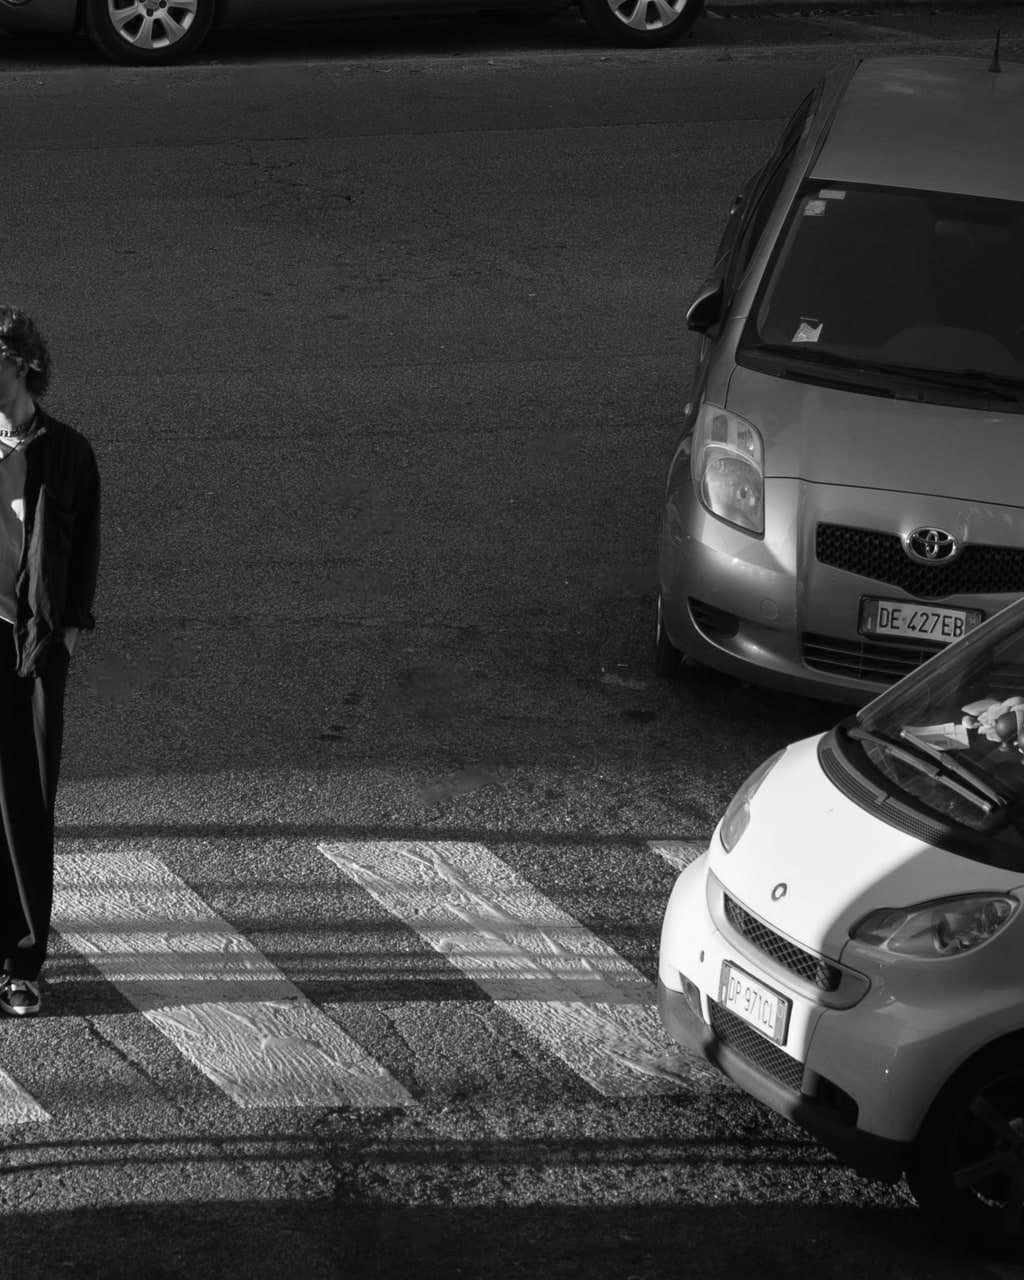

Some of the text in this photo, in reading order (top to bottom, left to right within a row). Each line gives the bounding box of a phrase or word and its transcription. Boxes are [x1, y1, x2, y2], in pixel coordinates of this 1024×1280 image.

[879, 607, 965, 638] DE 427EB
[728, 976, 773, 1029] DP 971CL
